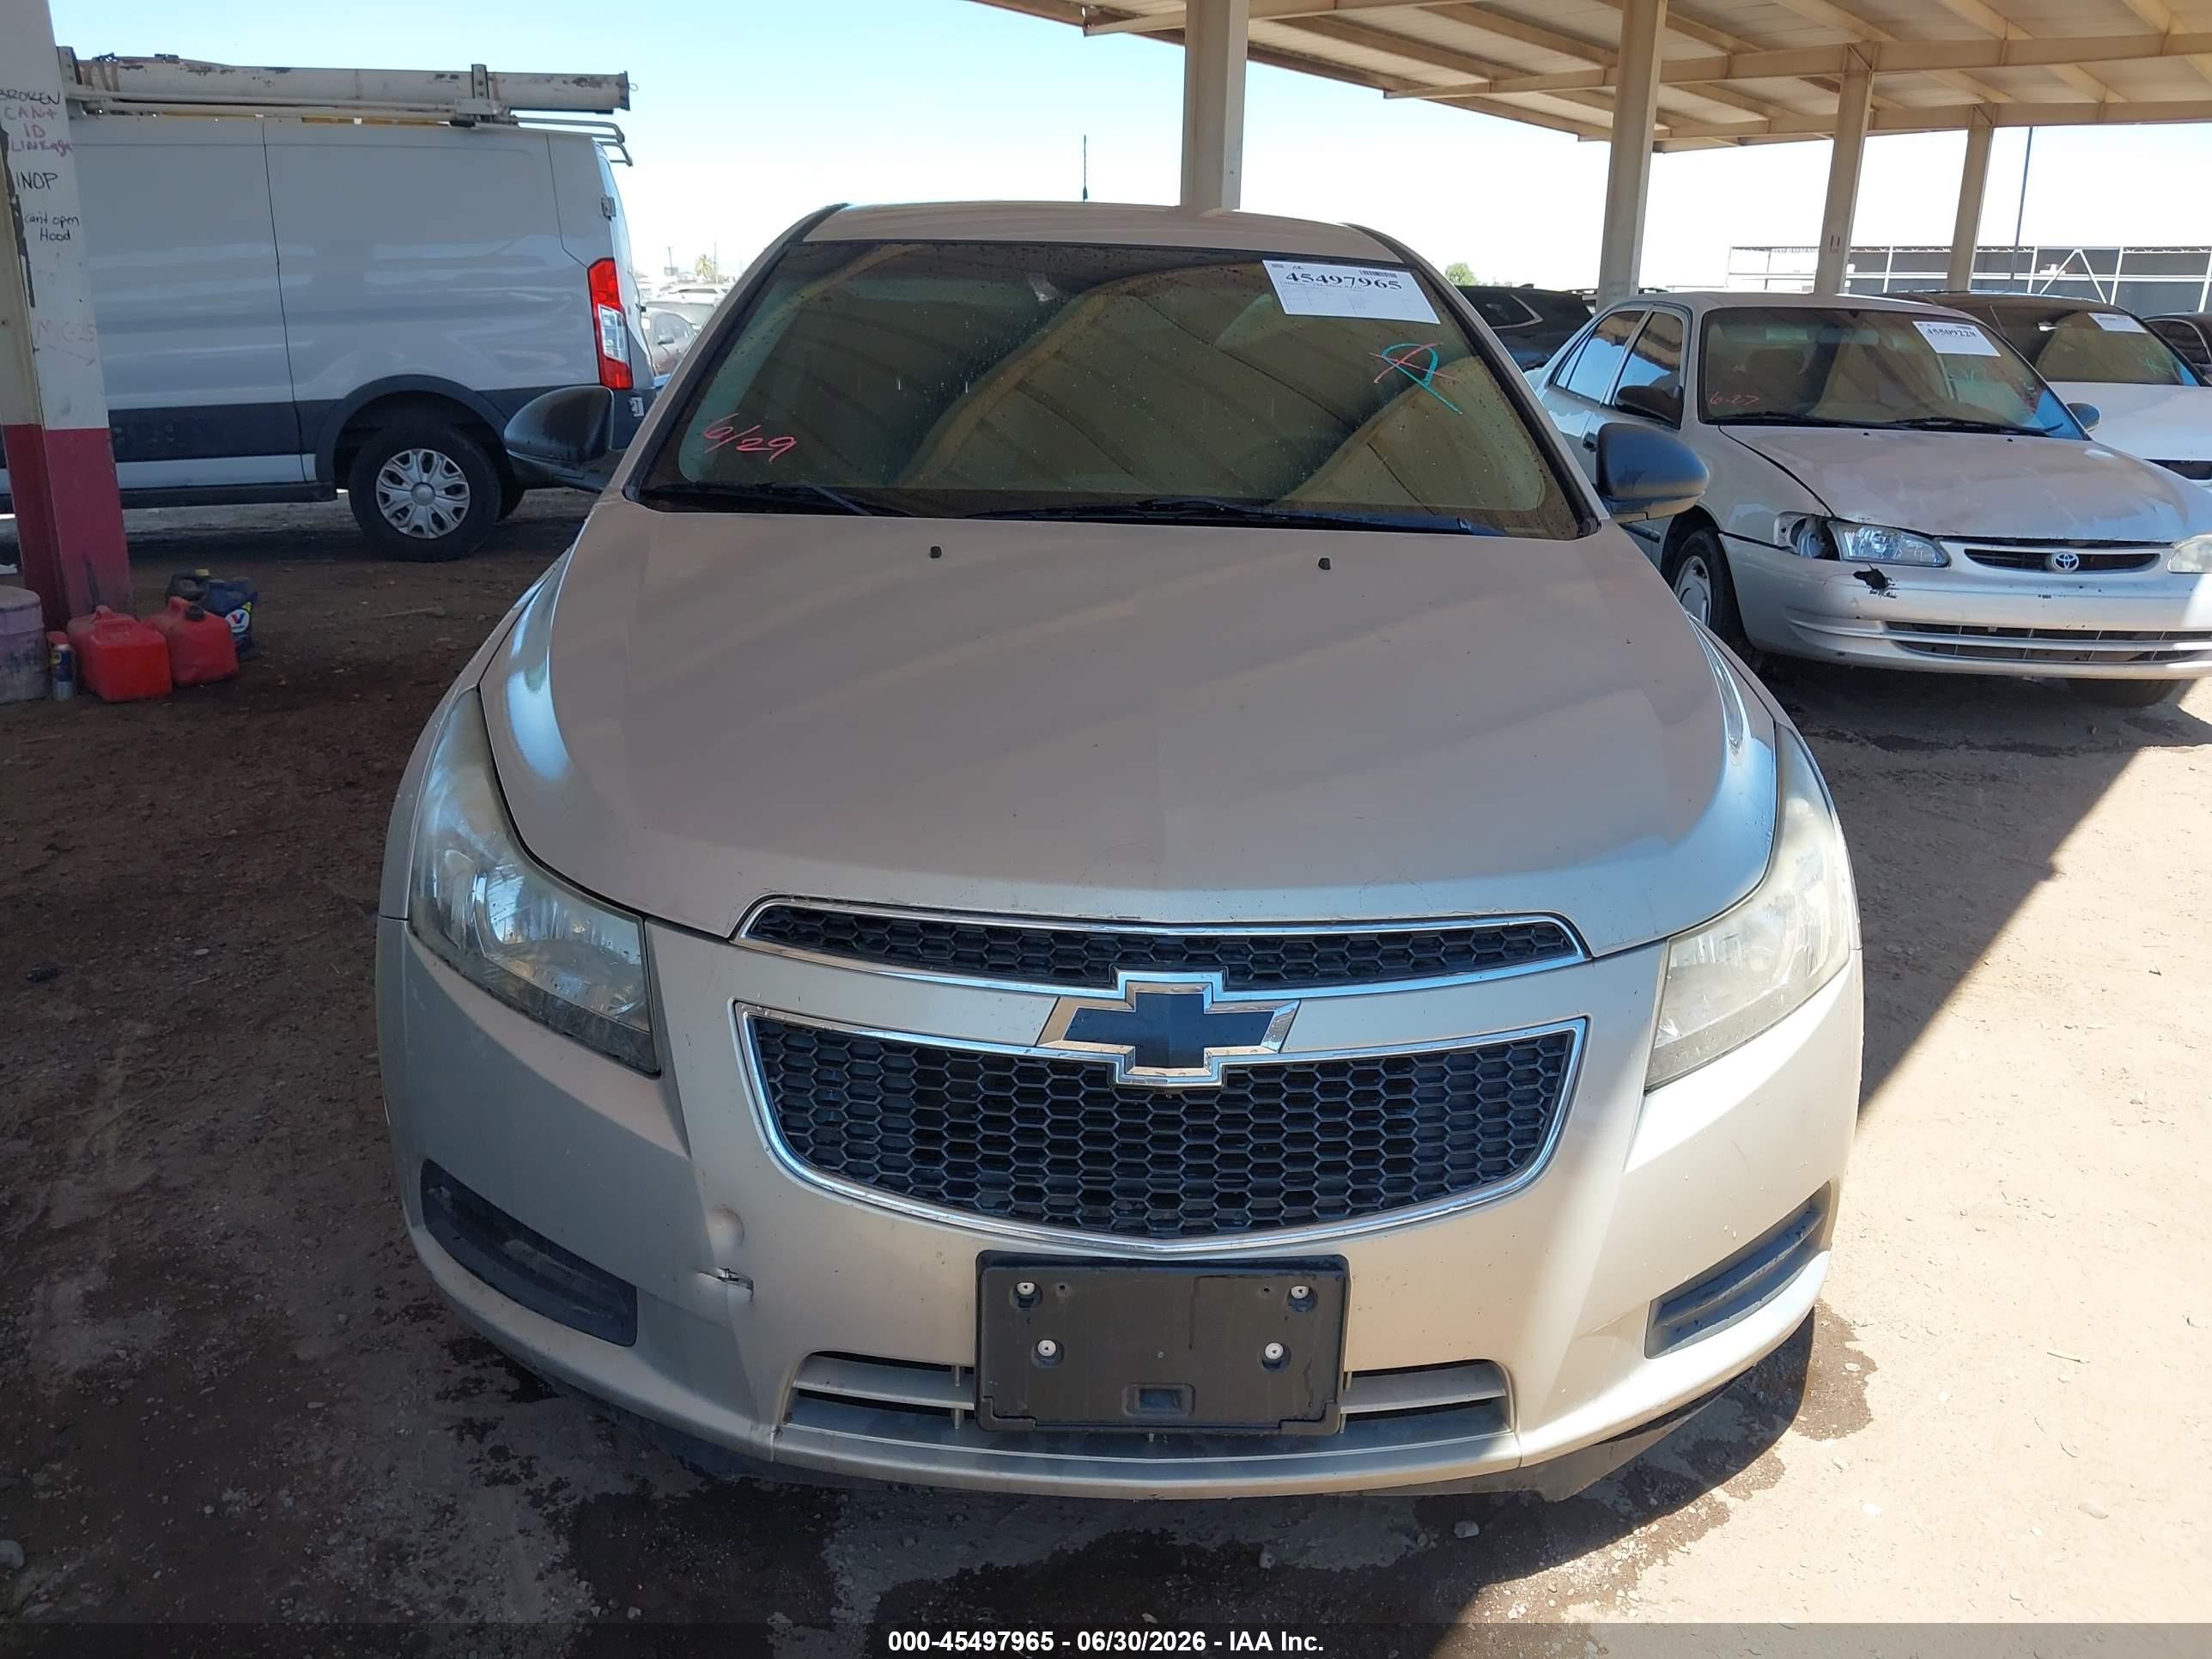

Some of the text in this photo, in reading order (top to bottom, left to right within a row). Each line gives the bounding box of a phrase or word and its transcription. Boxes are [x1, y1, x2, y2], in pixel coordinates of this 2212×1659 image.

[16, 172, 58, 190] INOP
[40, 228, 70, 241] Hood
[1285, 271, 1402, 290] 45497965
